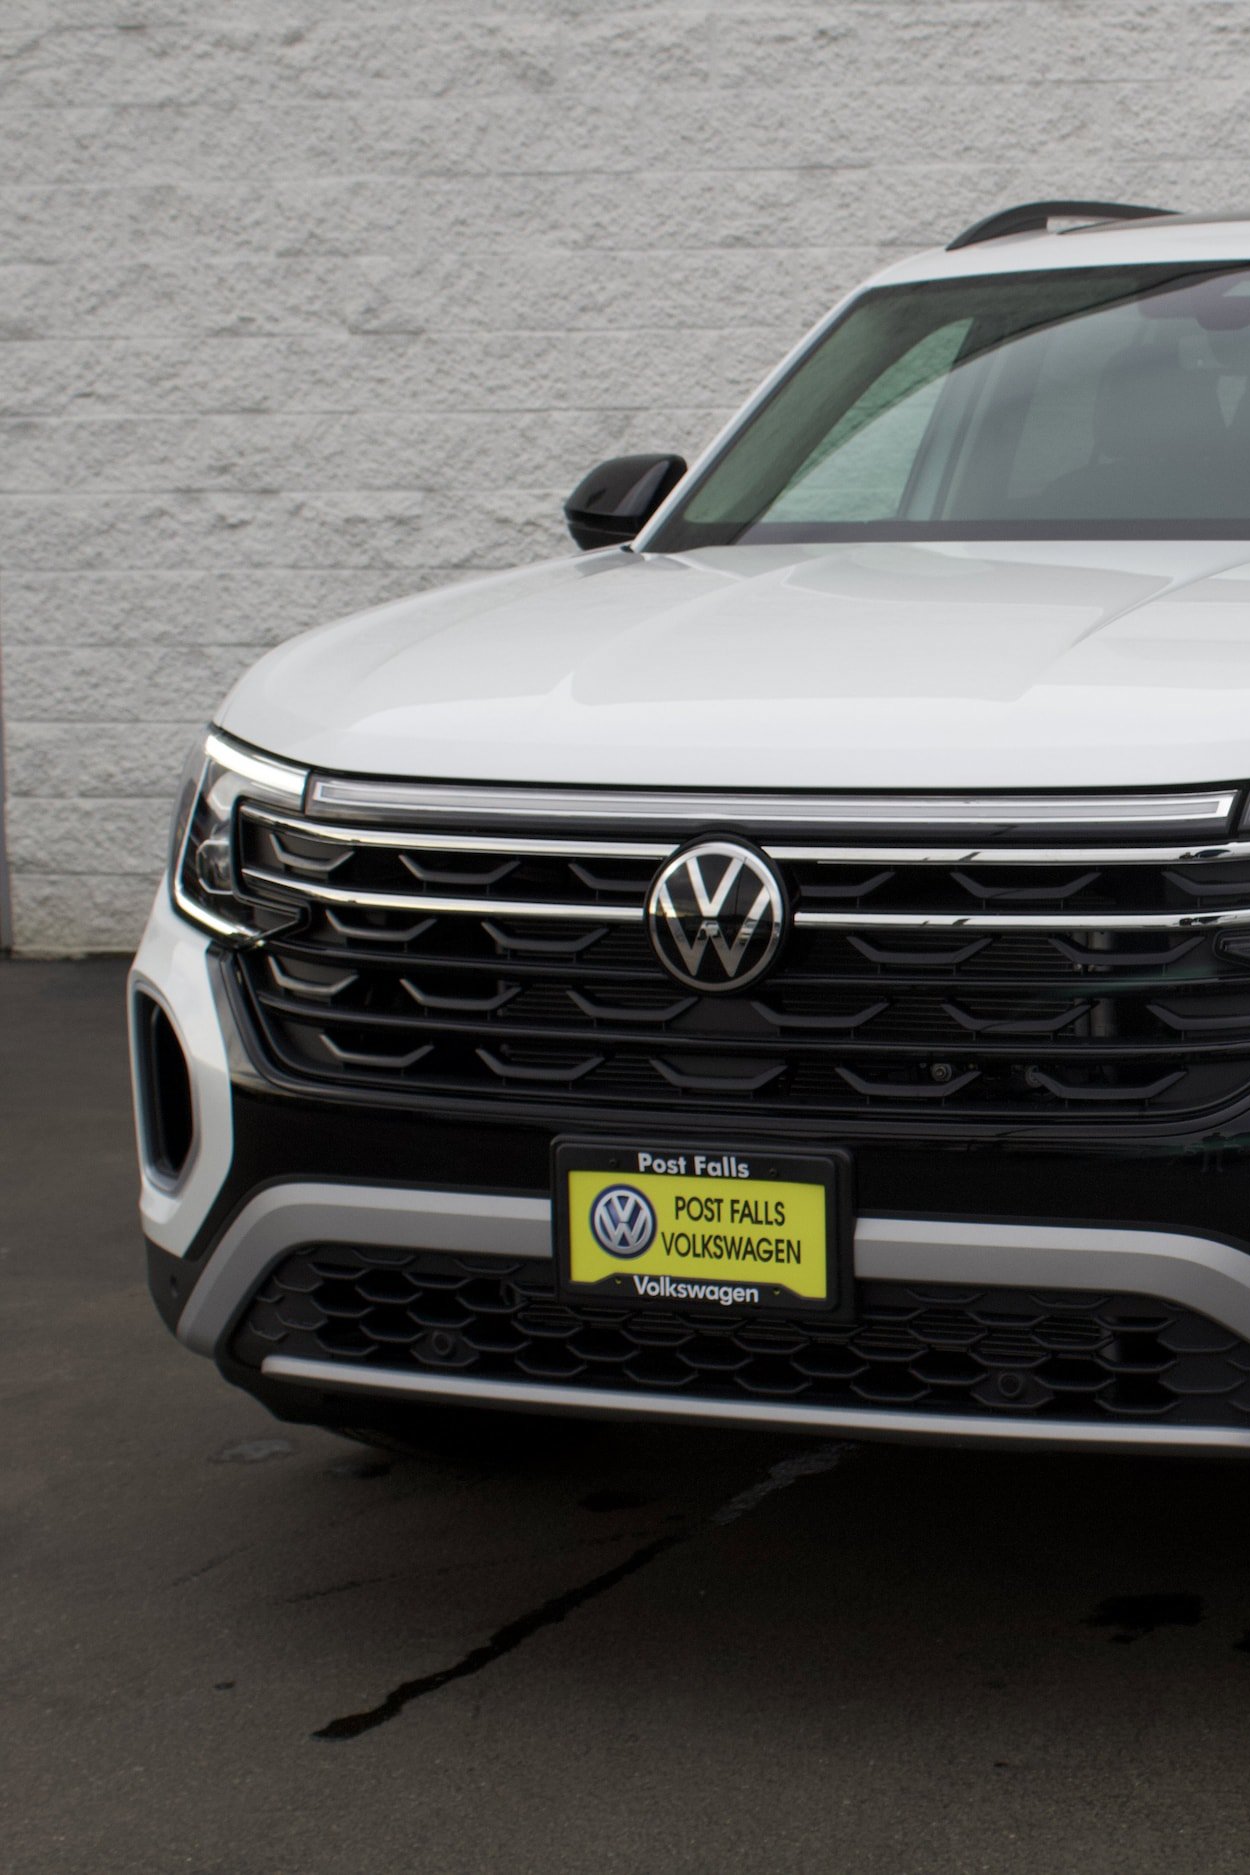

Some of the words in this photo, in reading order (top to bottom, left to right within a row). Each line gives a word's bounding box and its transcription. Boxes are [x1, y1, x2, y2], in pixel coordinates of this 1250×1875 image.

[638, 1153, 686, 1175] Post
[694, 1155, 750, 1178] Falls
[675, 1196, 724, 1223] POST
[731, 1199, 785, 1226] FALLS
[661, 1231, 802, 1265] VOLKSWAGEN
[633, 1275, 759, 1306] Volkswagen
